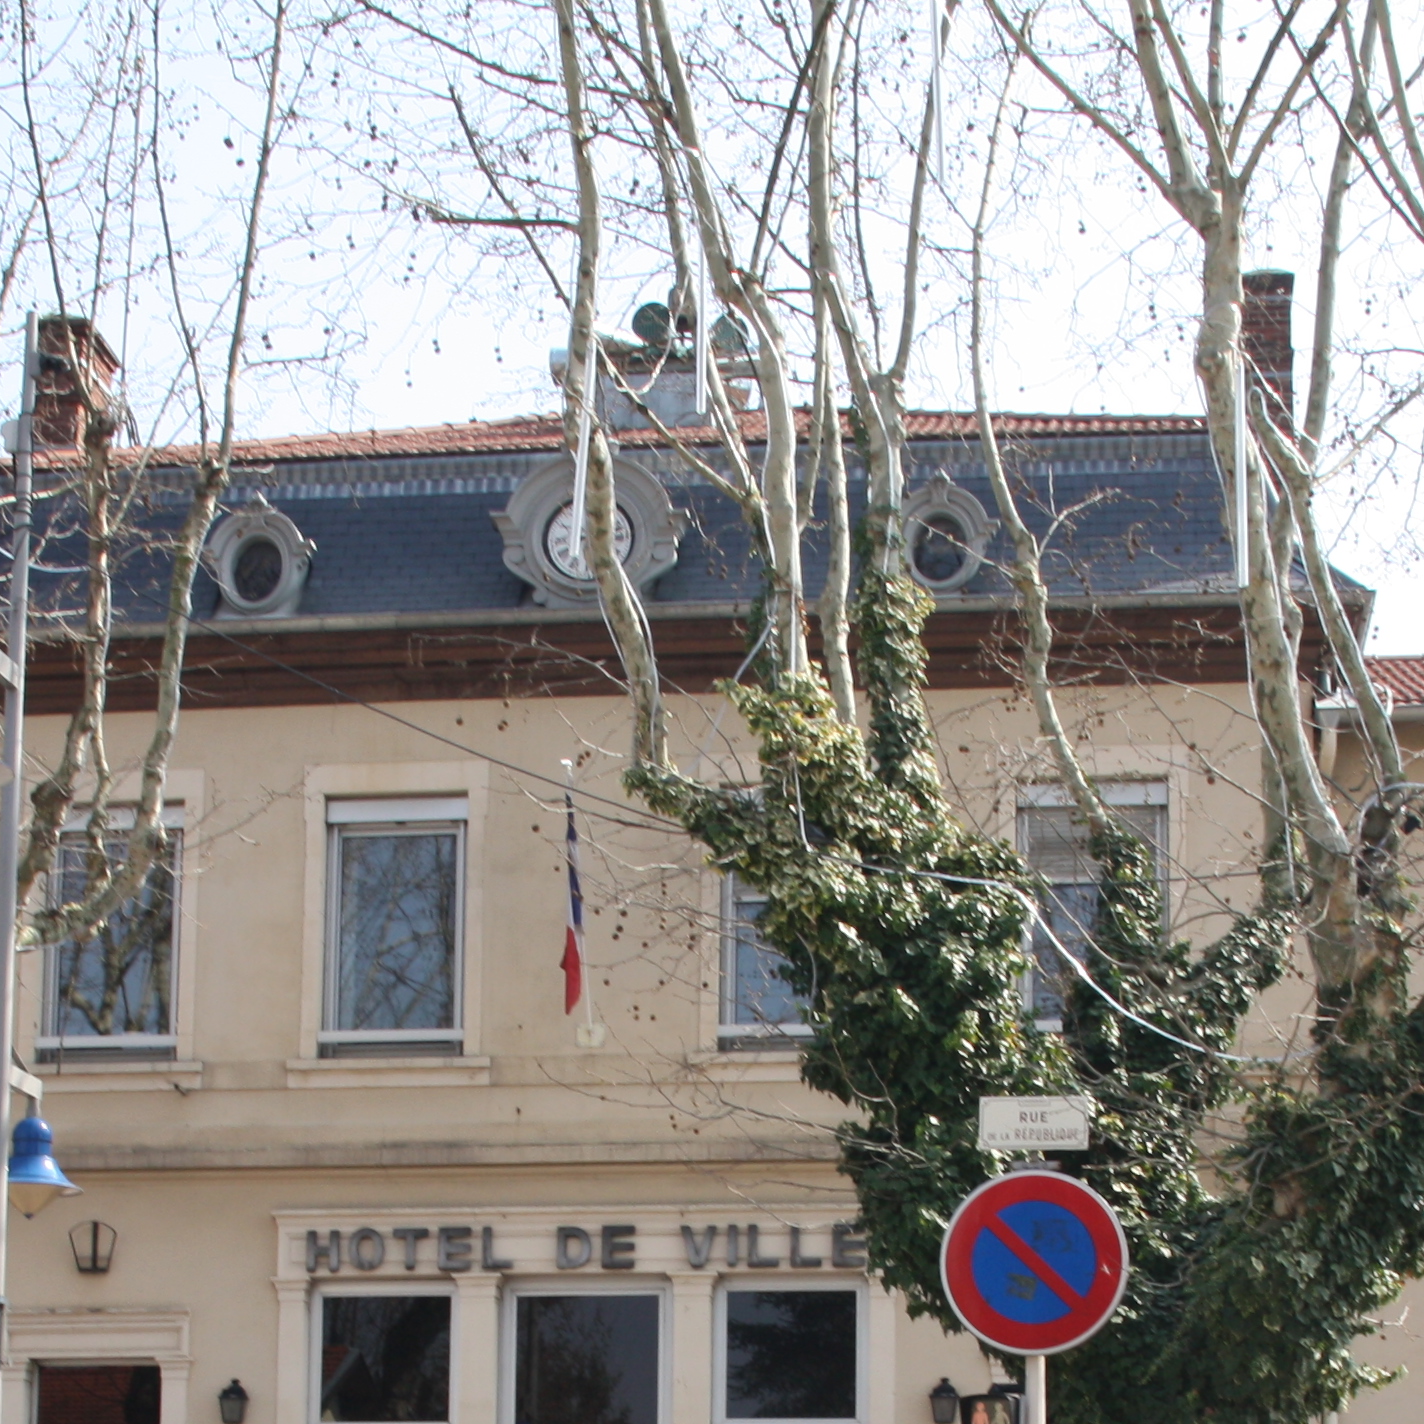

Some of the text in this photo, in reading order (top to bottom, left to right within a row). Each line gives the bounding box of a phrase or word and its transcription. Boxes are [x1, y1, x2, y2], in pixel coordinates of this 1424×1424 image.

[1019, 1111, 1048, 1123] RUE
[306, 1223, 867, 1273] HOTEL DE VILLE
